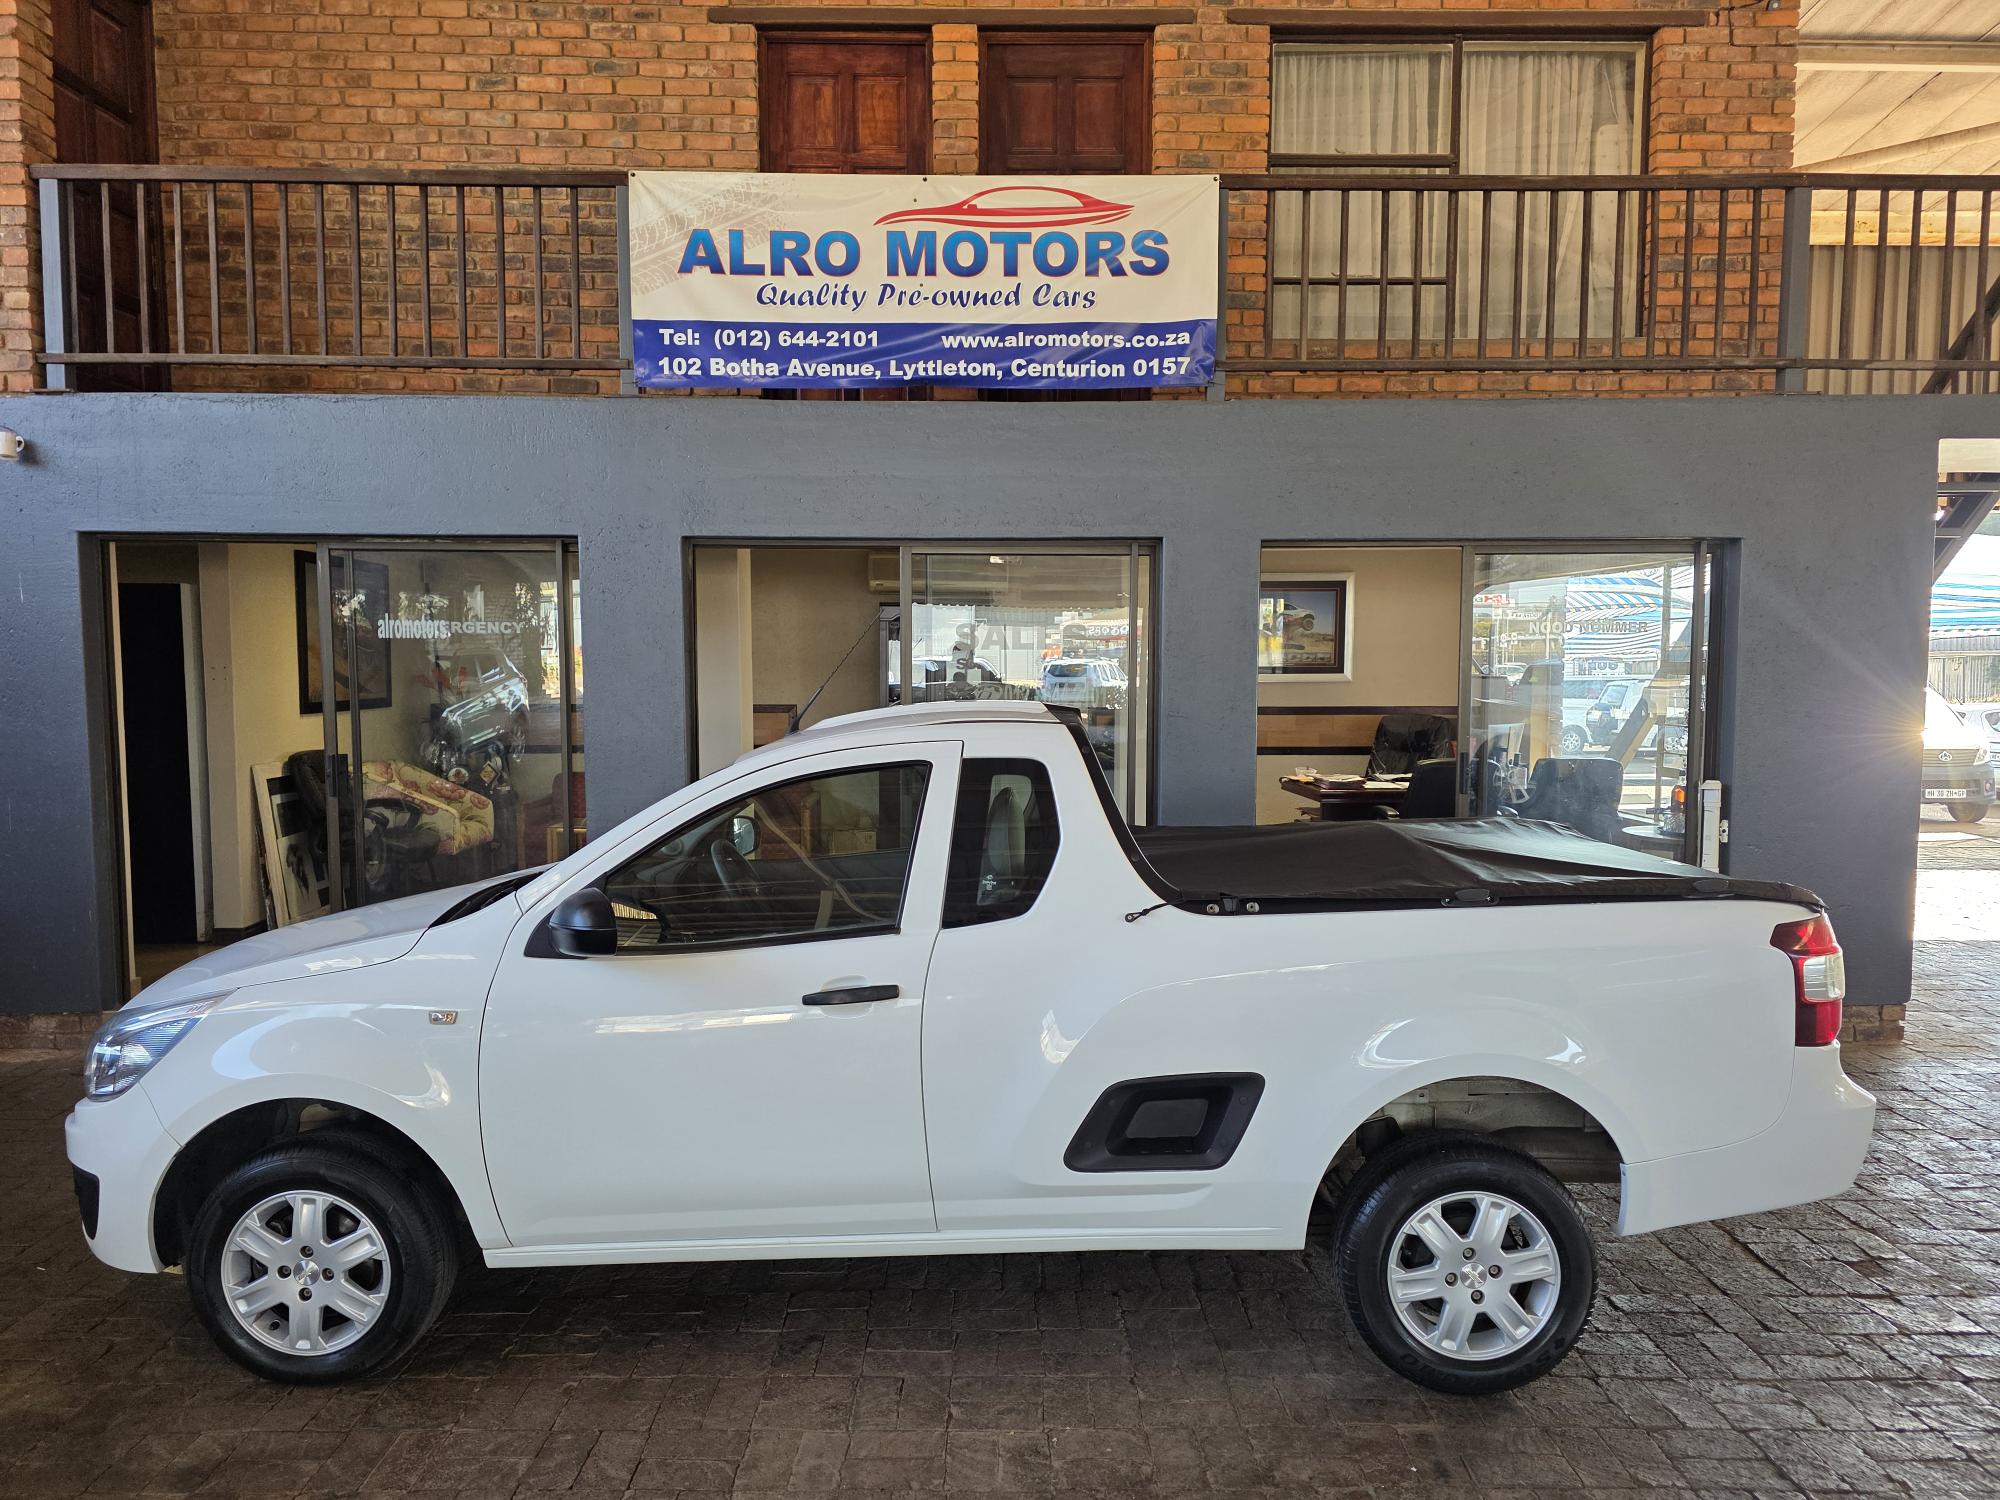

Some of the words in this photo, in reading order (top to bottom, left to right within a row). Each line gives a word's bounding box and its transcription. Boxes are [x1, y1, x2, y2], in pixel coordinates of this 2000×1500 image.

[677, 228, 861, 277] ALRO
[885, 229, 1170, 278] MOTORS
[756, 282, 867, 312] Quality
[877, 282, 1021, 308] Pre-owned
[1032, 283, 1096, 309] Cars
[658, 328, 701, 346] Tel:
[713, 329, 771, 350] (012)
[777, 330, 879, 348] 644-2101
[941, 331, 1191, 349] www.alromotors.co.za
[658, 356, 702, 376] 102
[709, 357, 780, 377] Botha
[786, 359, 881, 381] Avenue,
[889, 359, 1004, 381] Lyttleton,
[1010, 358, 1126, 377] Centurion
[1132, 356, 1191, 376] 0157
[1528, 621, 1574, 634] NOOD
